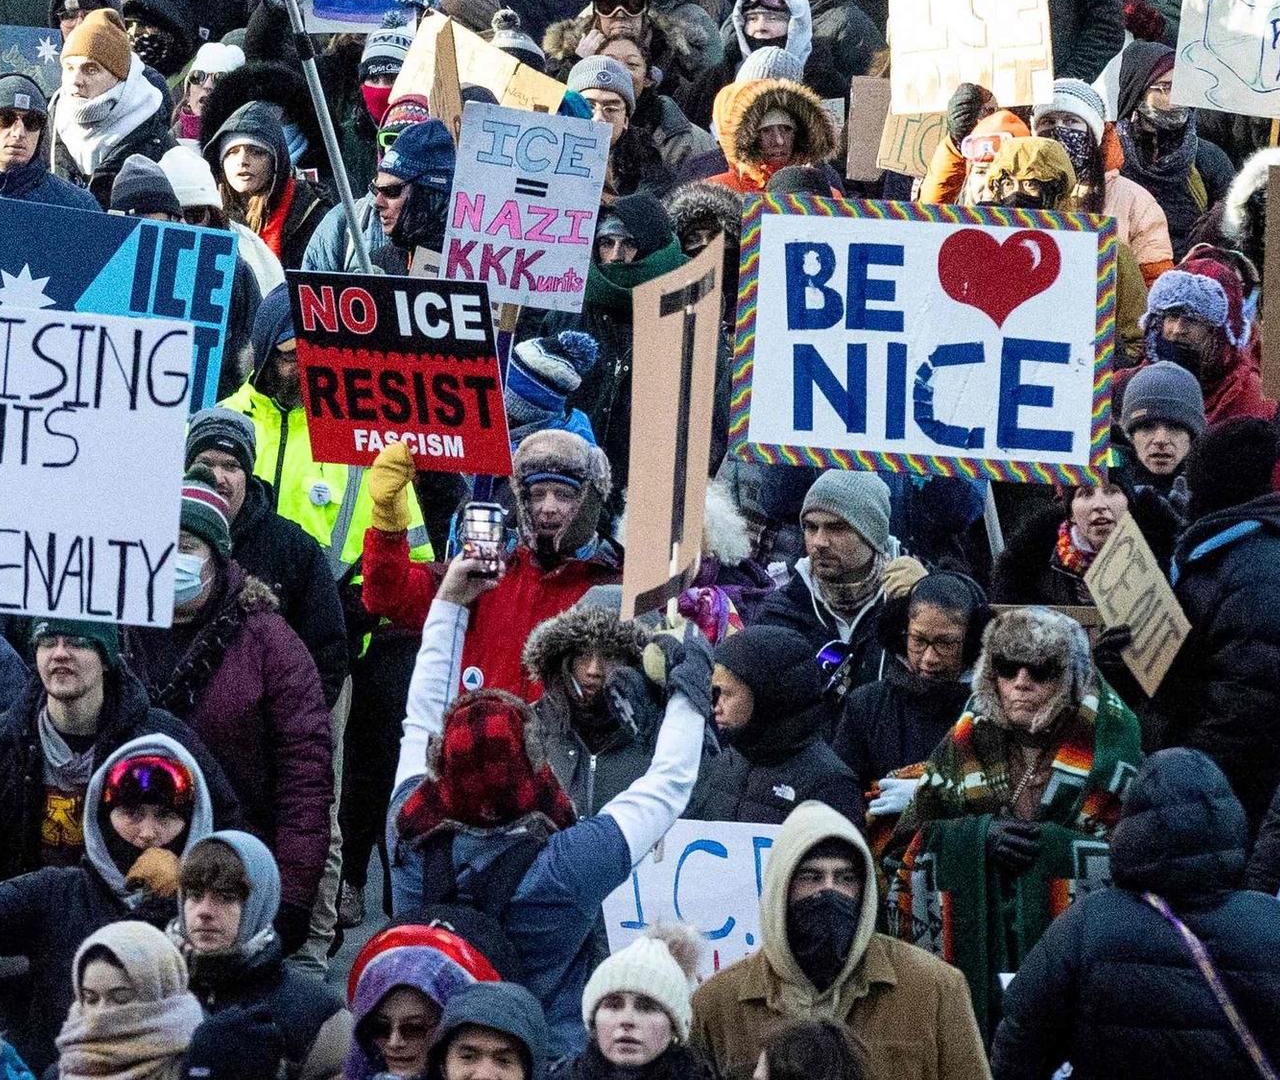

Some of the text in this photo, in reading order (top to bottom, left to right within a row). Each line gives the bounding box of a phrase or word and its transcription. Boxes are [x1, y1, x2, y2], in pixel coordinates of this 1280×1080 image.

[476, 119, 598, 180] ICE
[451, 190, 595, 246] NAZI
[129, 223, 235, 322] ICE
[445, 238, 586, 295] KKKunts
[784, 241, 906, 334] BE
[298, 284, 488, 342] NO ICE
[307, 365, 497, 429] RESIST
[792, 337, 1075, 453] NICE
[353, 428, 465, 459] FASCISM
